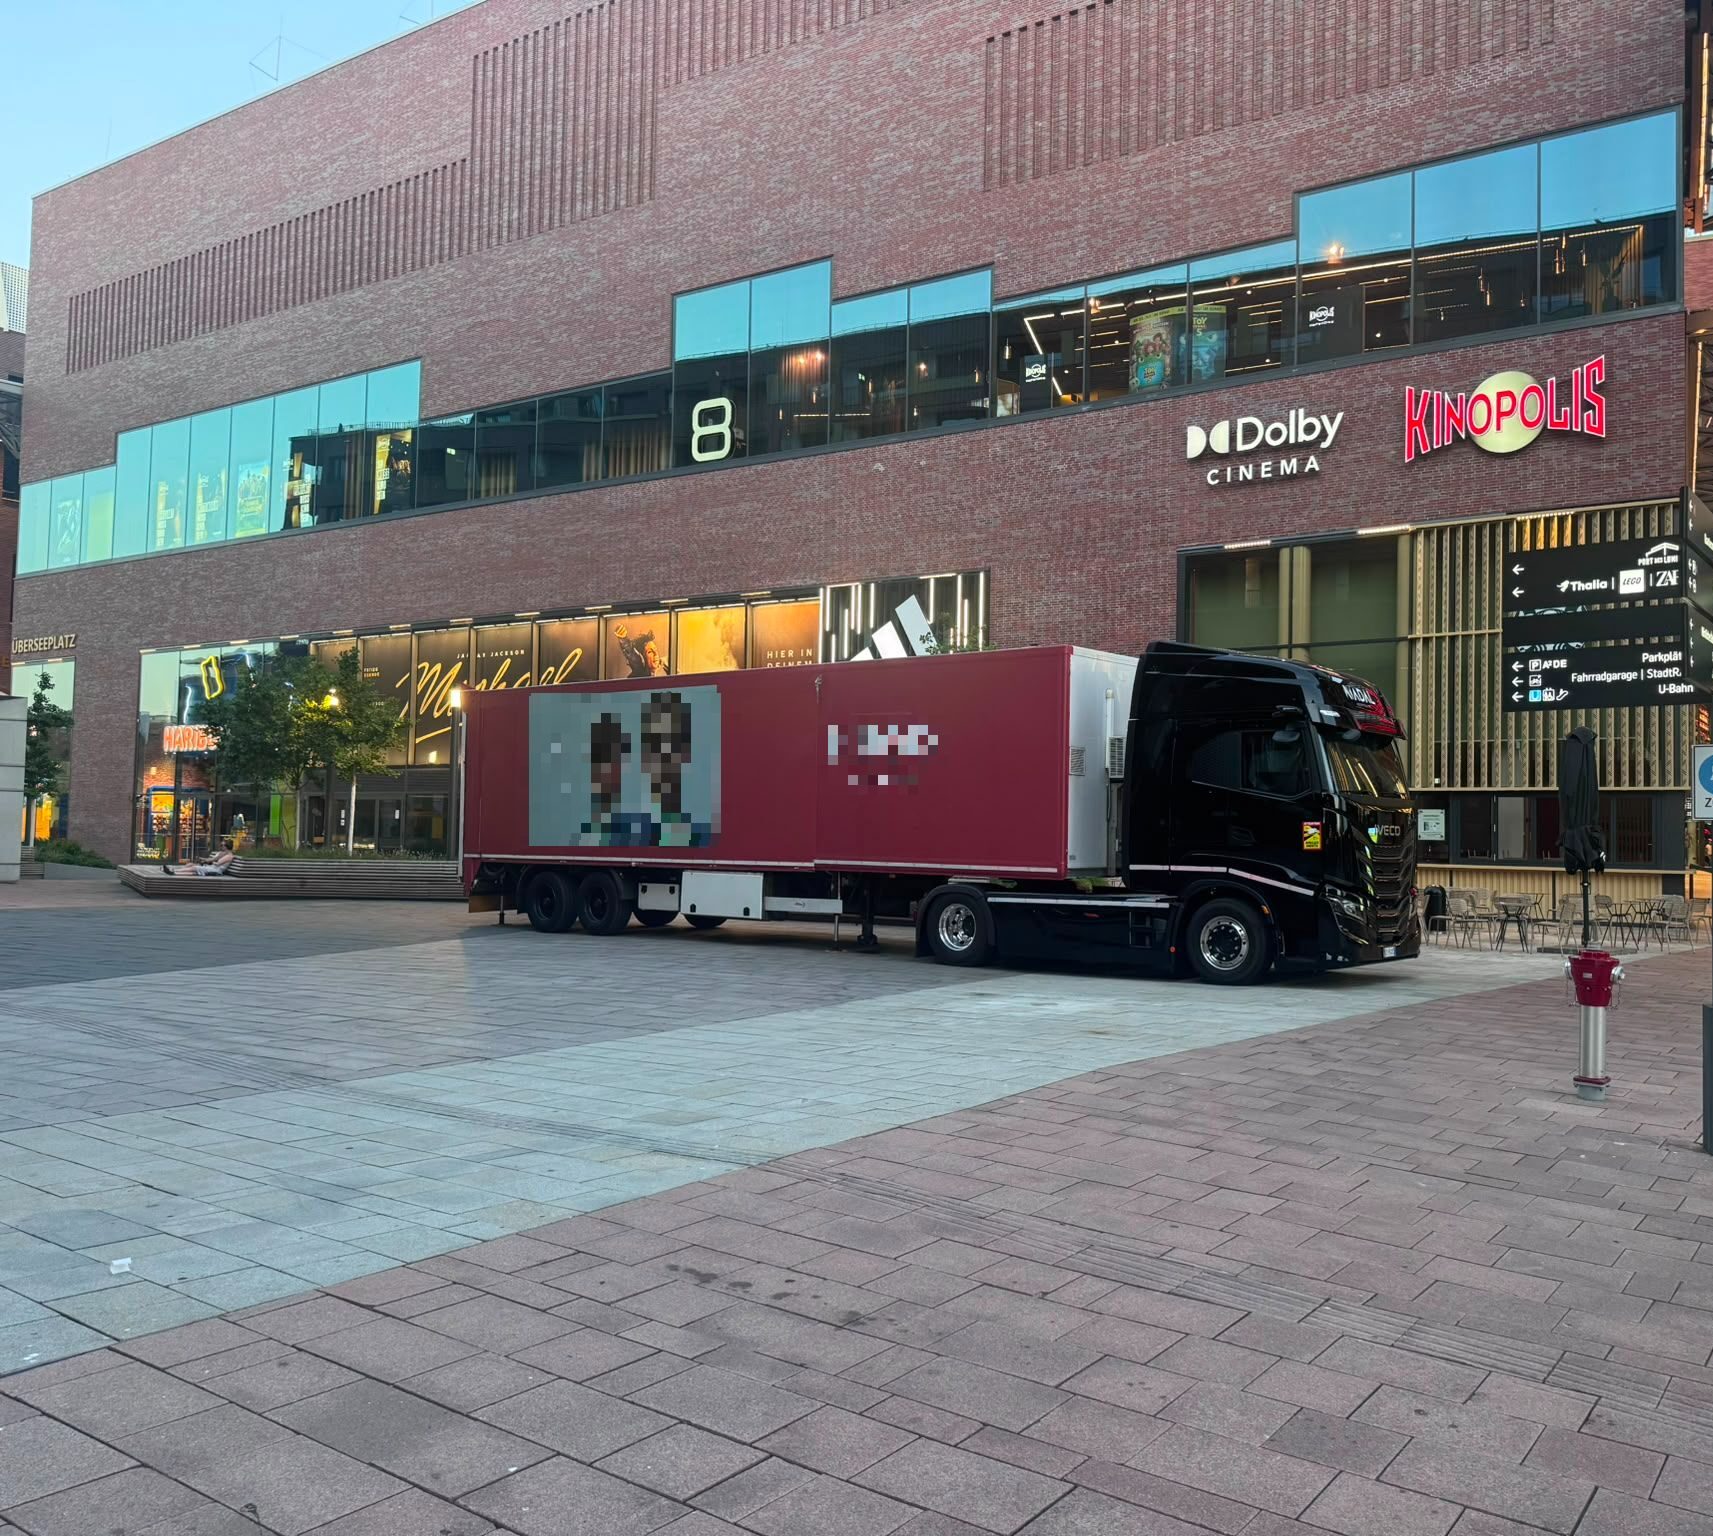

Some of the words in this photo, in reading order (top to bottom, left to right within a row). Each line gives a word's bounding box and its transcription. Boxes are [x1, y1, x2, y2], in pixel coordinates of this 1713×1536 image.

[1404, 355, 1606, 463] KINOPOLIS
[691, 397, 732, 462] 8
[1235, 409, 1344, 452] Dolby
[1206, 455, 1321, 486] CINEMA
[1571, 580, 1607, 592] Thalia
[11, 633, 76, 654] ÜBERSEEPLATZ
[767, 650, 794, 659] HIER
[800, 648, 813, 657] IN
[1571, 671, 1638, 683] Fahrradgarage
[1658, 683, 1694, 694] U-Bahn
[1375, 824, 1401, 836] IVECO
